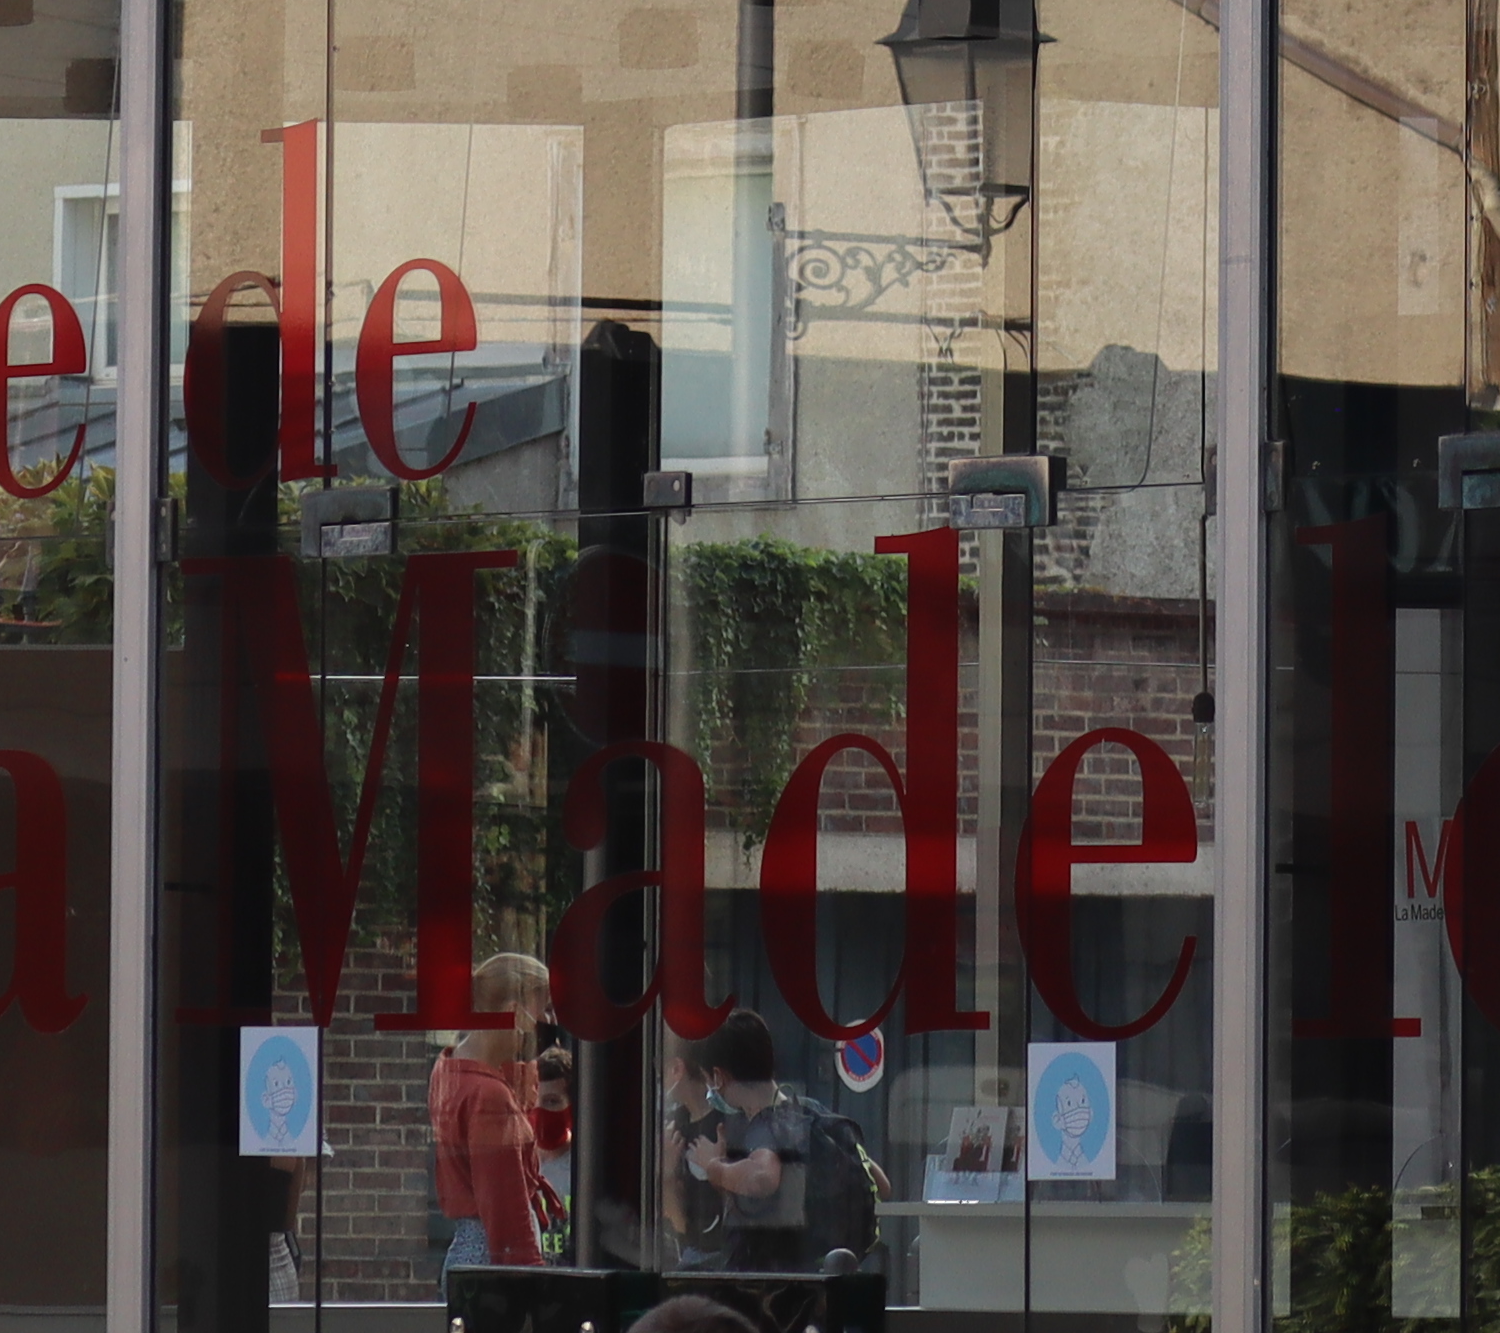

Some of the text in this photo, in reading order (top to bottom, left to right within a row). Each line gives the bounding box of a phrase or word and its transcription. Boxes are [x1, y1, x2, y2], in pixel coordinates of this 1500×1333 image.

[184, 118, 479, 493] de
[1395, 904, 1444, 921] La Made
